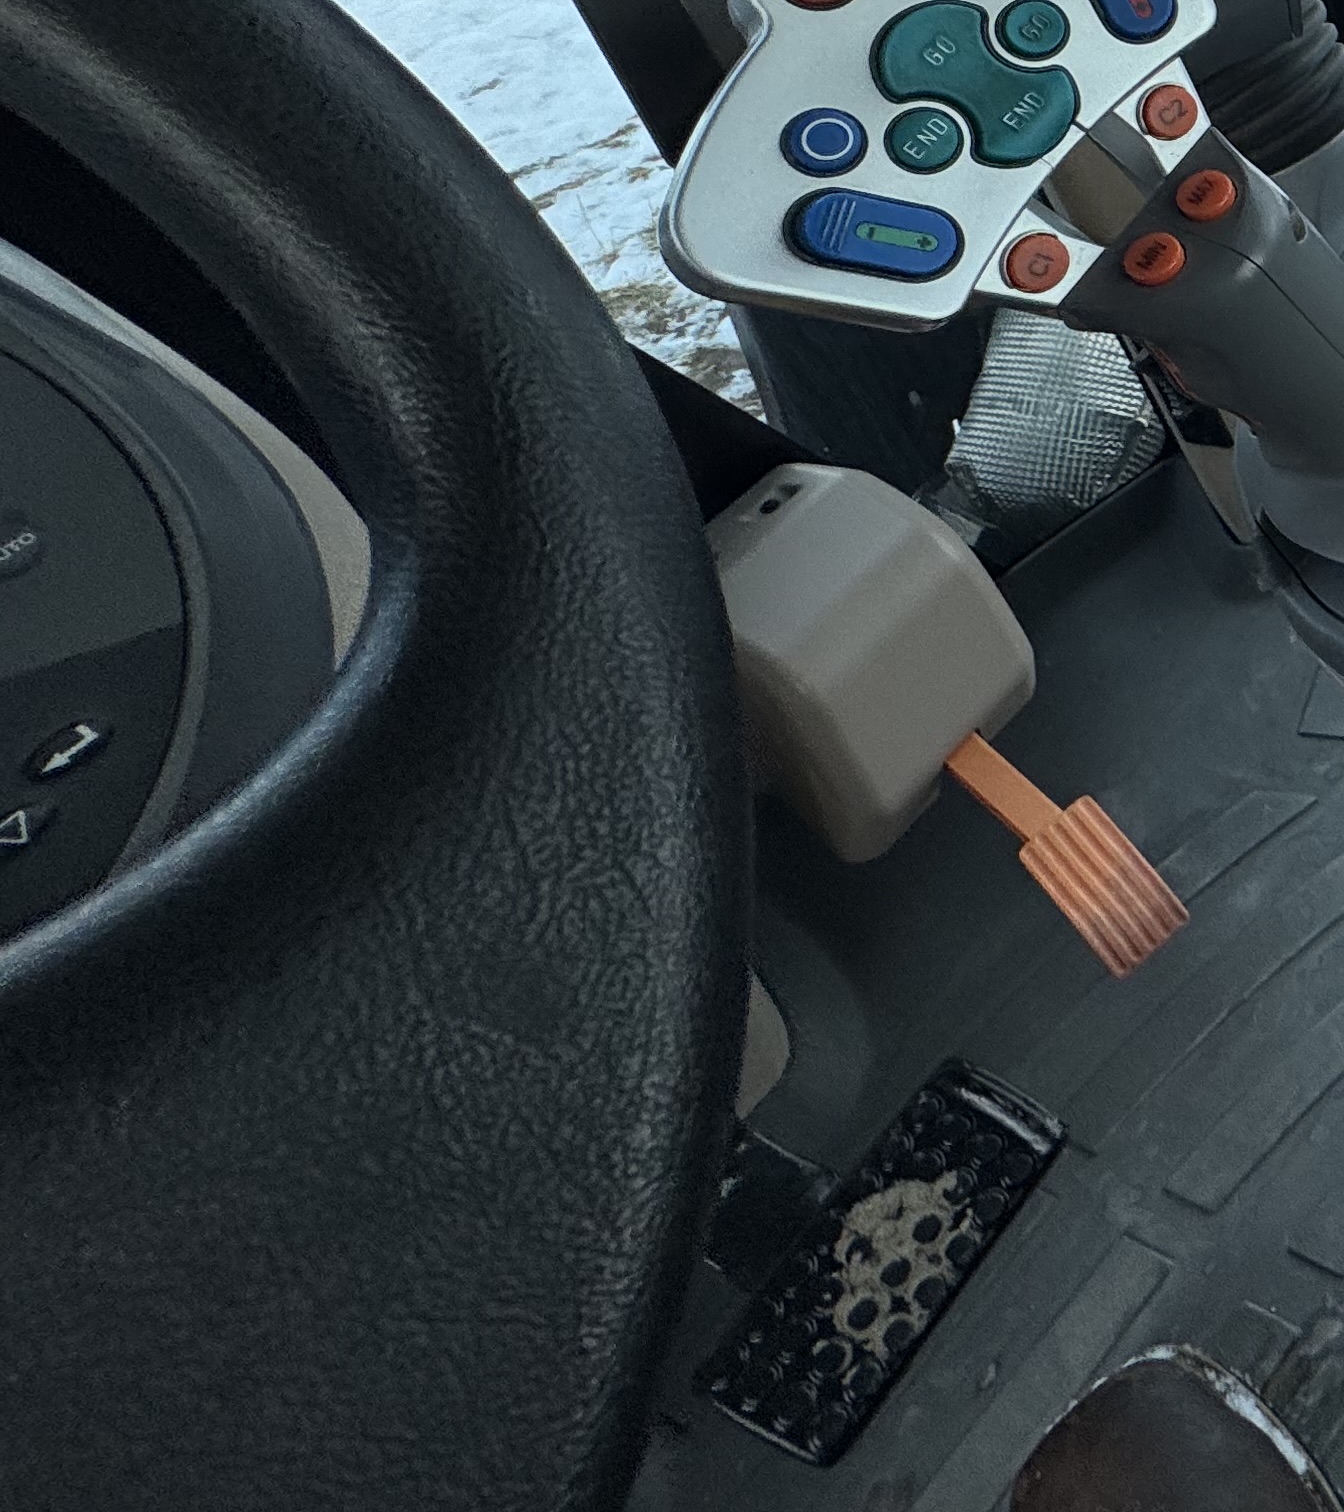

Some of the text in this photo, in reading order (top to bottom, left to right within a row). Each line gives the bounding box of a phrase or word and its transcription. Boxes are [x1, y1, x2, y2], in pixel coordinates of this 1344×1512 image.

[1020, 12, 1052, 43] GO
[922, 34, 958, 68] GO
[1001, 90, 1046, 131] END
[1158, 99, 1189, 126] C2
[901, 117, 949, 161] END
[1186, 176, 1214, 206] MAX
[1027, 252, 1054, 278] C1
[1136, 239, 1168, 269] MIN
